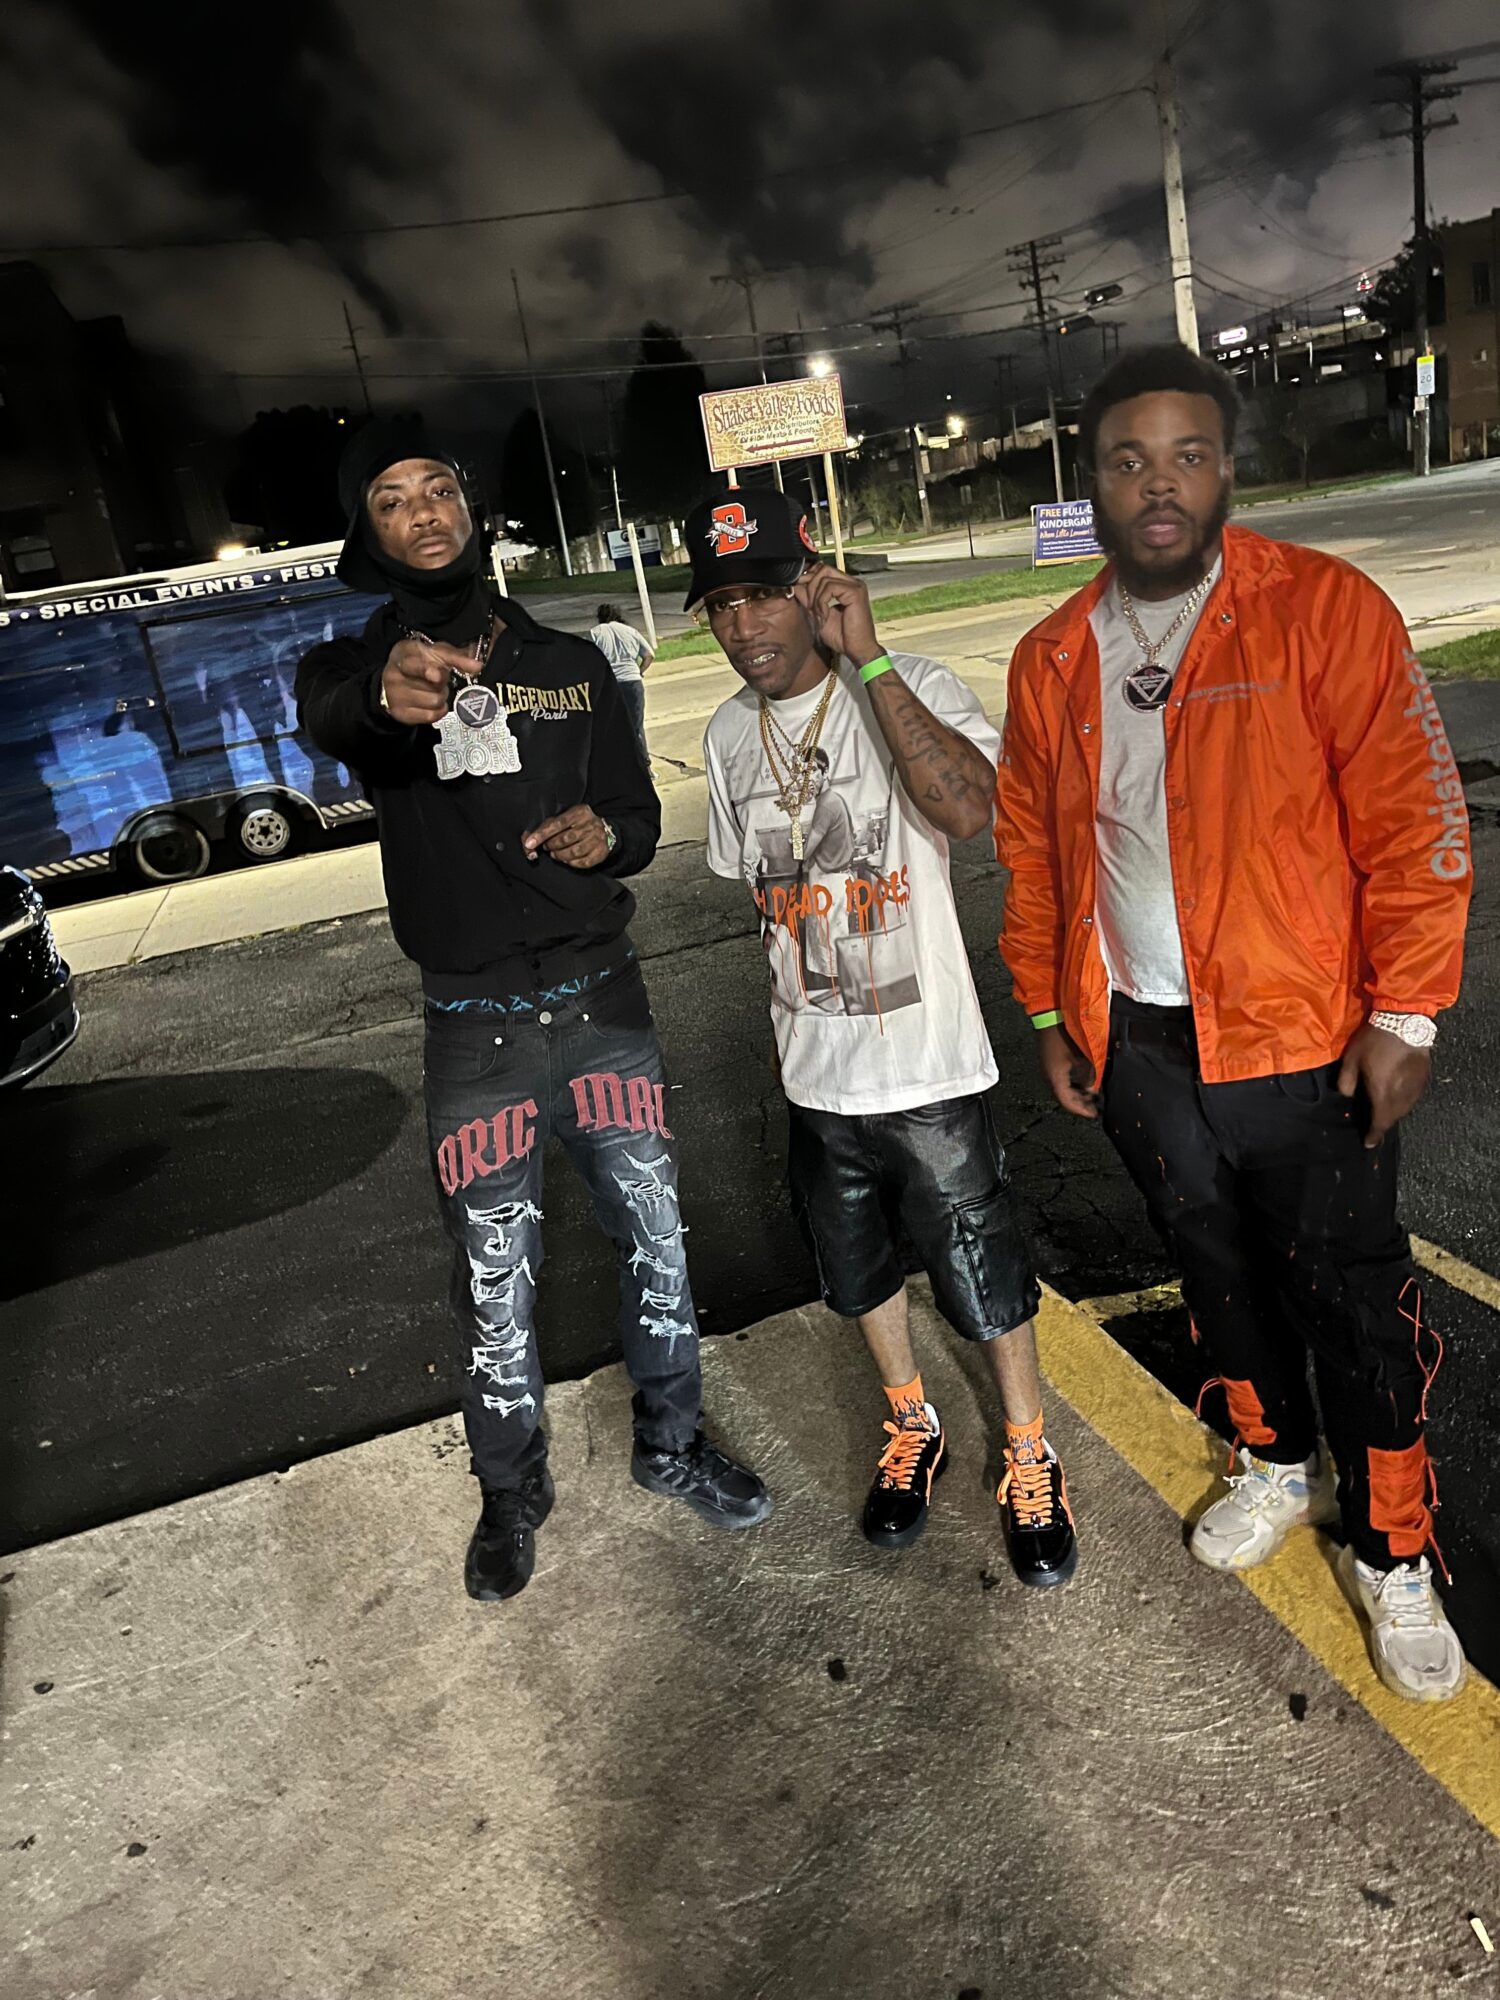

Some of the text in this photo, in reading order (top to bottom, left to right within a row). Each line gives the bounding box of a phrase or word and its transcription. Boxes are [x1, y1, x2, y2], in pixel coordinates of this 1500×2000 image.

[1420, 374, 1432, 384] 20
[713, 388, 836, 433] Shaker Valley Foods
[1040, 508, 1061, 518] FREE
[39, 592, 150, 620] SPECIAL
[156, 574, 255, 602] EVENTS
[280, 561, 338, 584] FEST
[496, 681, 592, 714] LEGENDARY
[530, 707, 568, 721] Paris
[433, 736, 522, 780] DON
[1401, 647, 1470, 880] Christopher
[771, 881, 833, 924] DEAD
